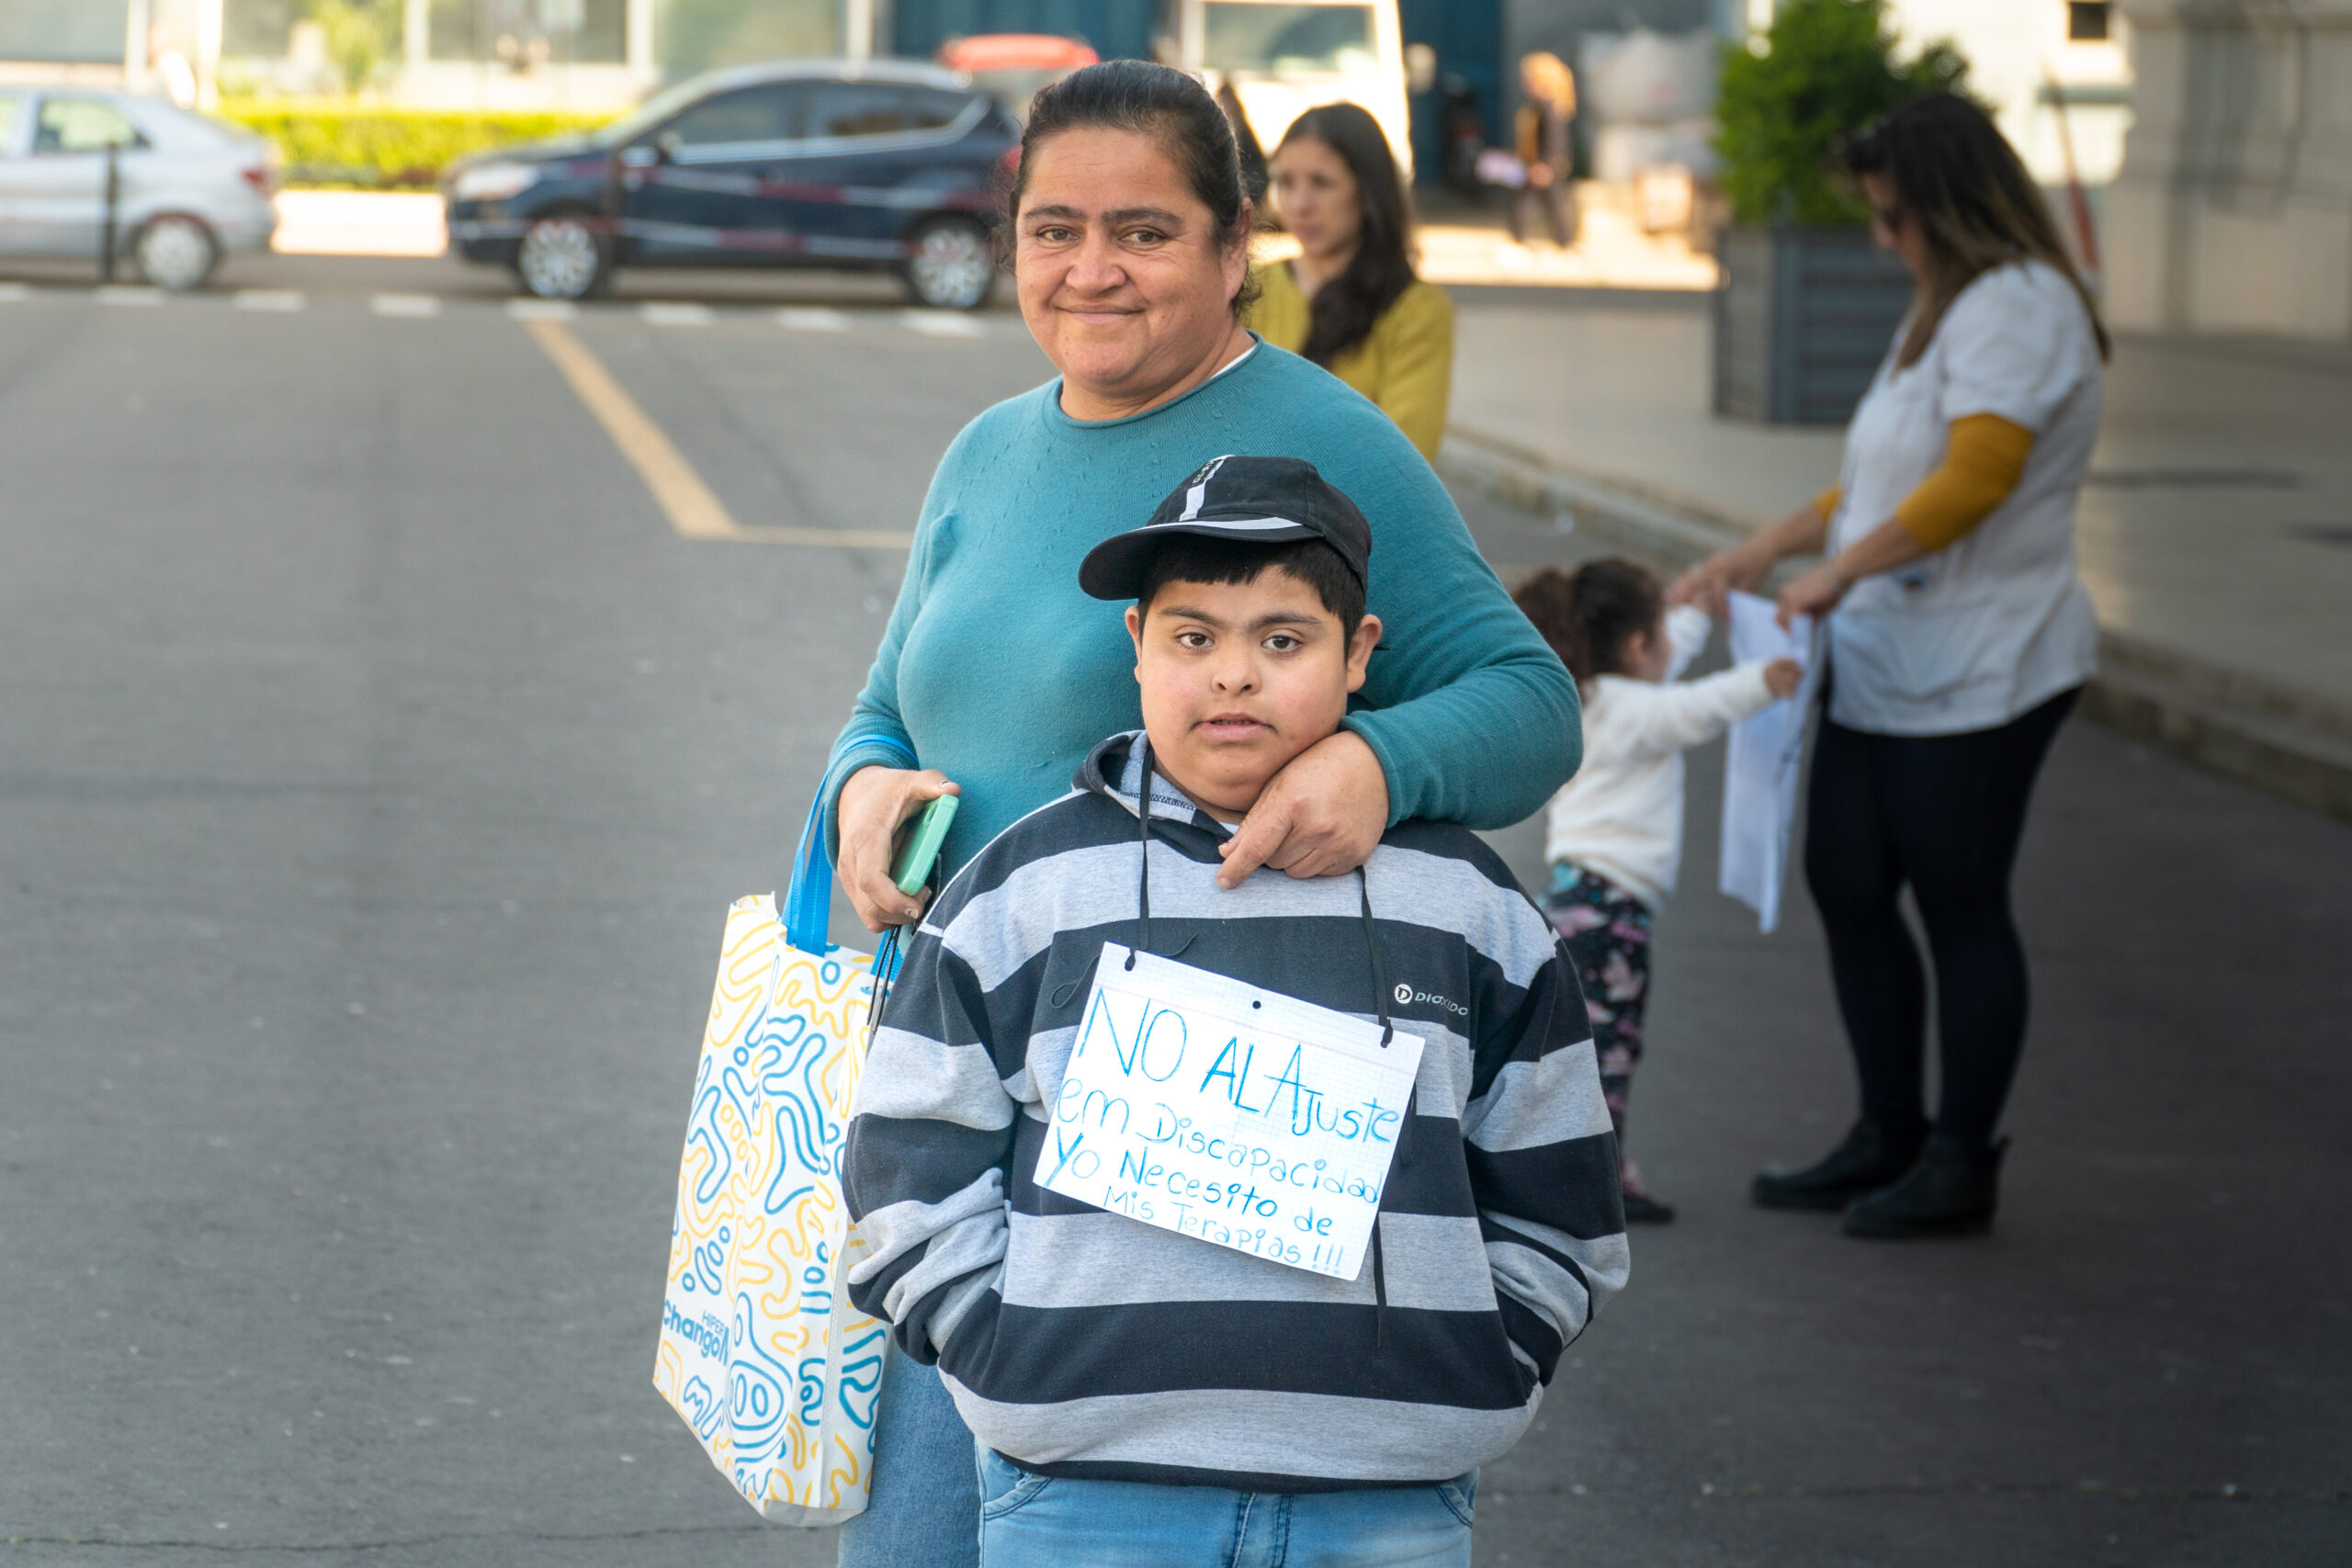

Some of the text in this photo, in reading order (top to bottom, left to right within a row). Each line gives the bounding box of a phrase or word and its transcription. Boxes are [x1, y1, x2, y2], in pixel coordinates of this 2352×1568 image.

[1077, 987, 1188, 1082] NO
[1199, 1035, 1261, 1114] AL
[1044, 1125, 1334, 1237] Yo Necesito de
[1102, 1185, 1154, 1220] Mis
